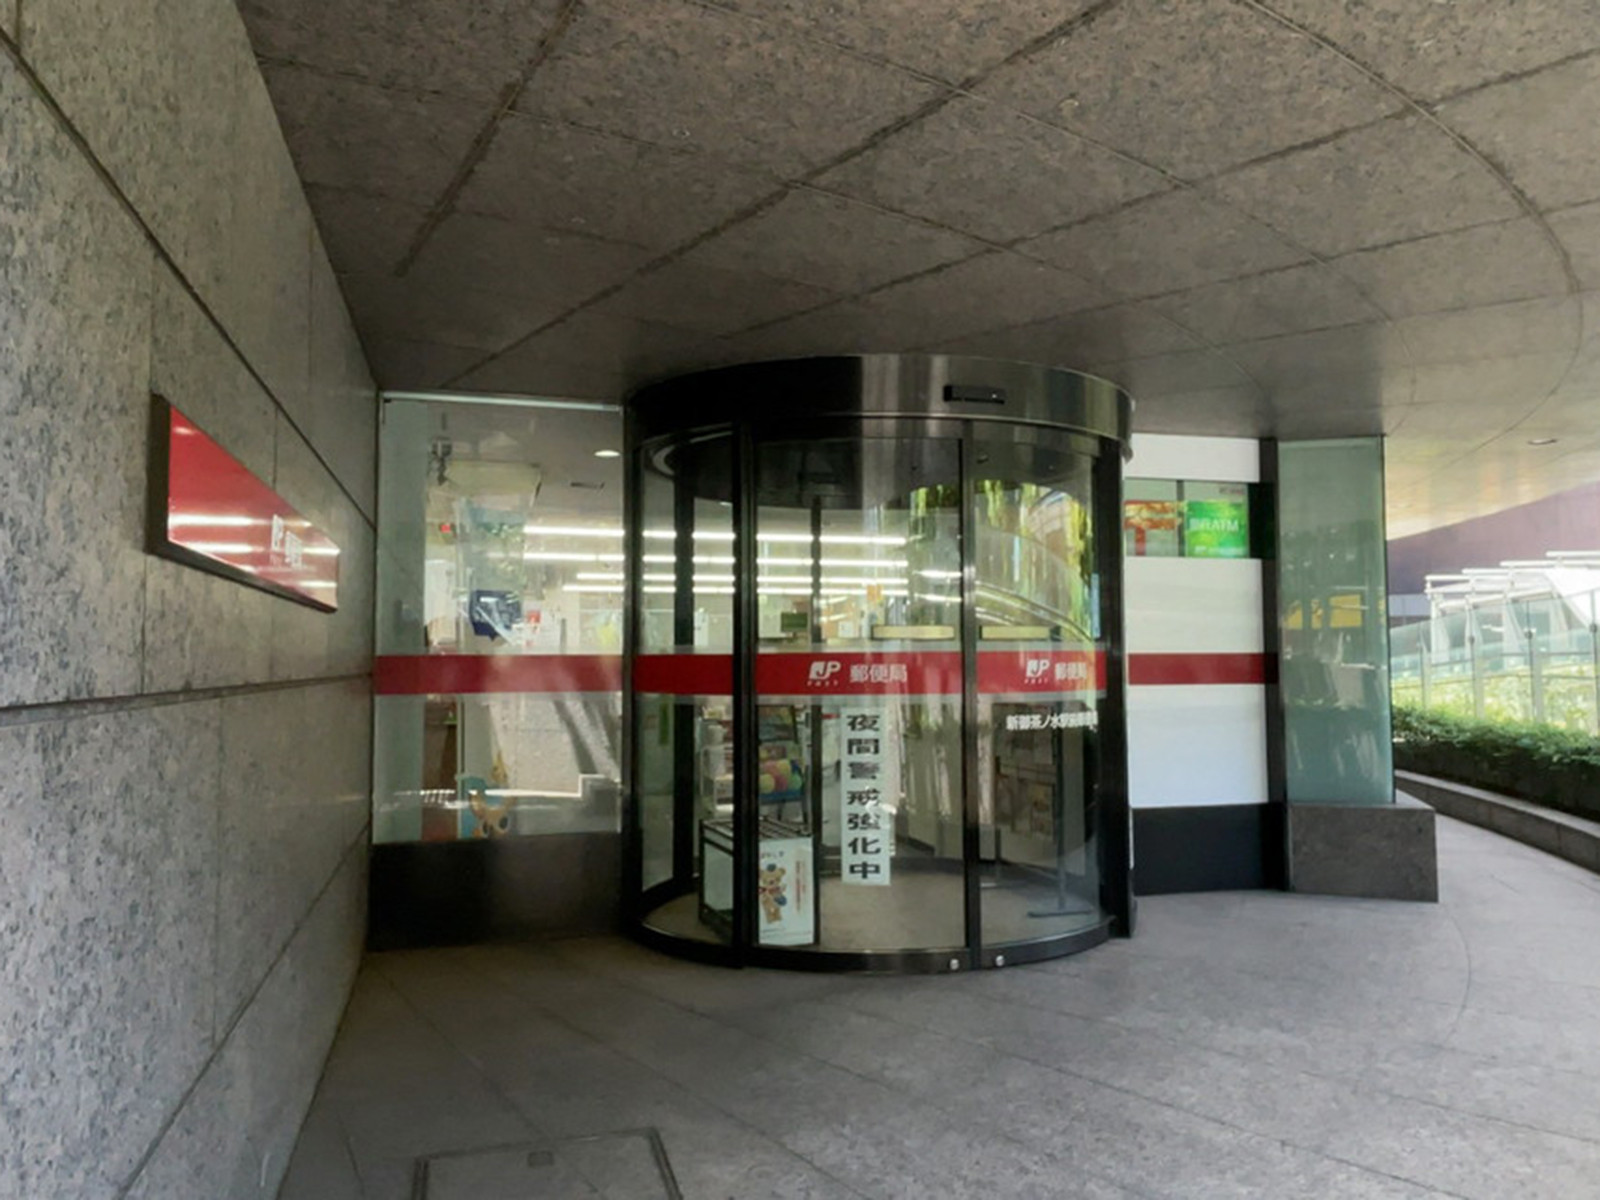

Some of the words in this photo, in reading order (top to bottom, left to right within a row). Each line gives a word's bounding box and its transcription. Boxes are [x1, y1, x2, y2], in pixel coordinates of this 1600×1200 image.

[808, 661, 842, 680] JP
[1026, 659, 1051, 678] JP
[847, 713, 881, 879] 夜間警戒強化中
